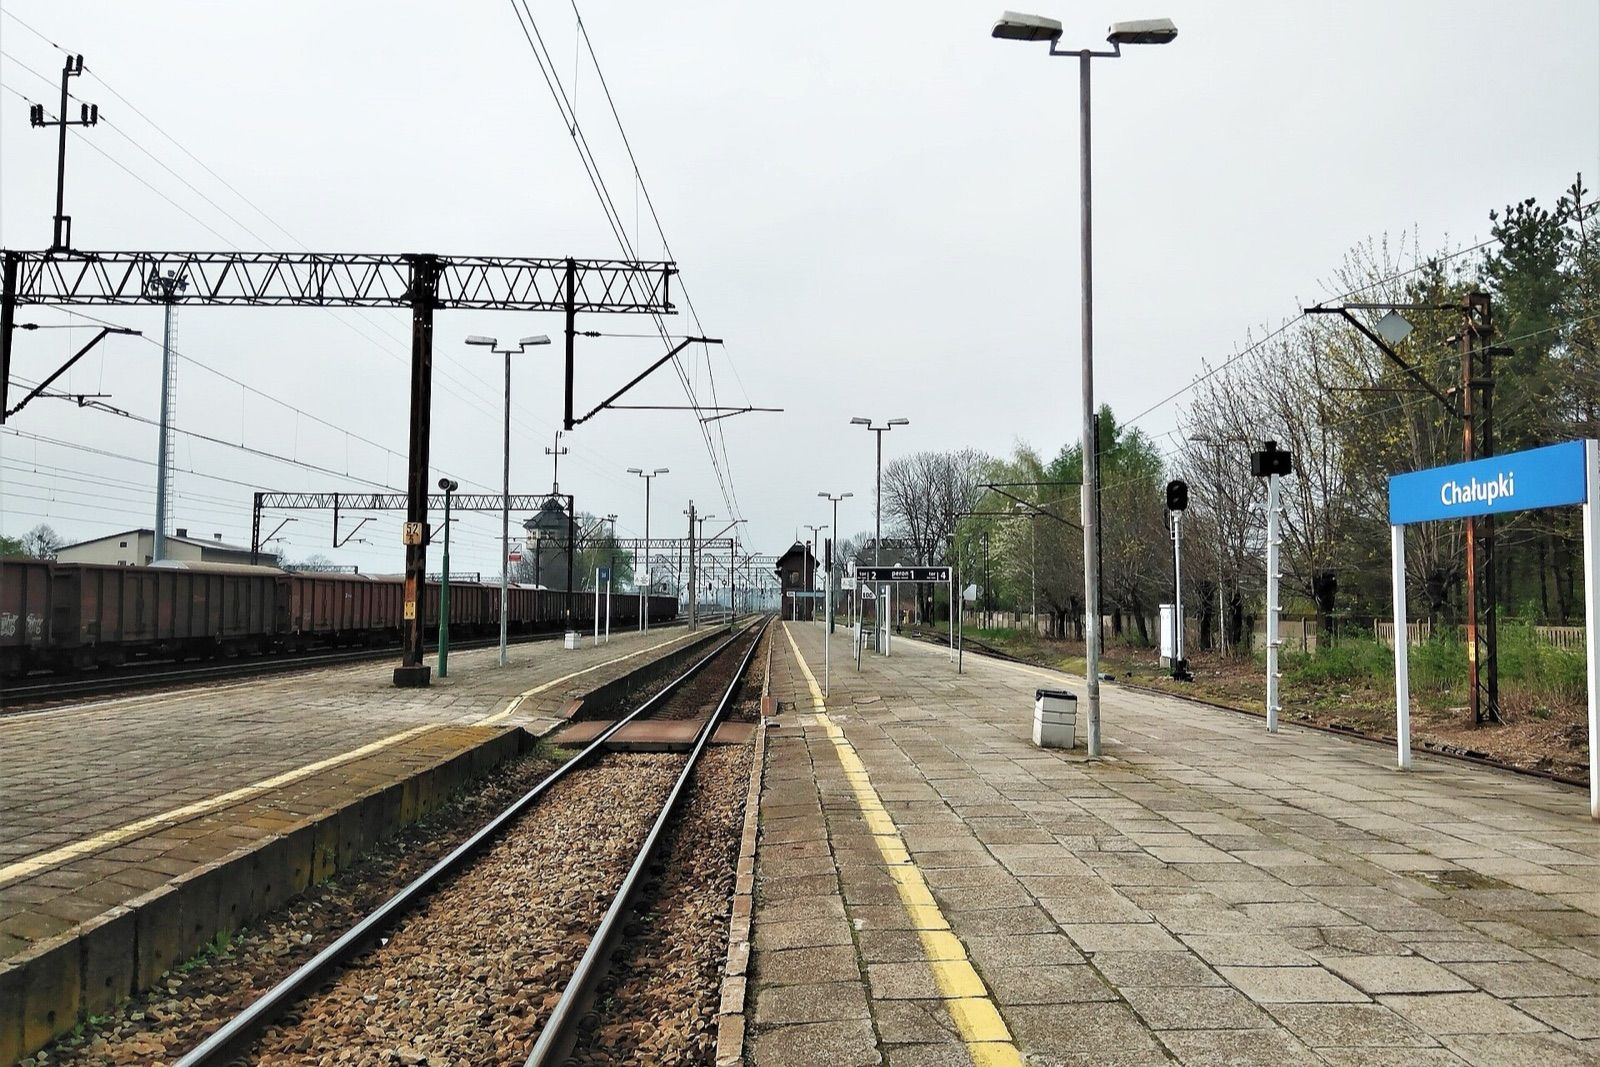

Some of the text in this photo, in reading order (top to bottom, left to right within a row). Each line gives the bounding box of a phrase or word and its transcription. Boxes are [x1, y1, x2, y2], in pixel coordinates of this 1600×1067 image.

[1441, 471, 1514, 506] Chałupki
[407, 523, 418, 534] 52
[871, 571, 877, 579] 2
[910, 570, 914, 579] 1
[940, 571, 946, 579] 4
